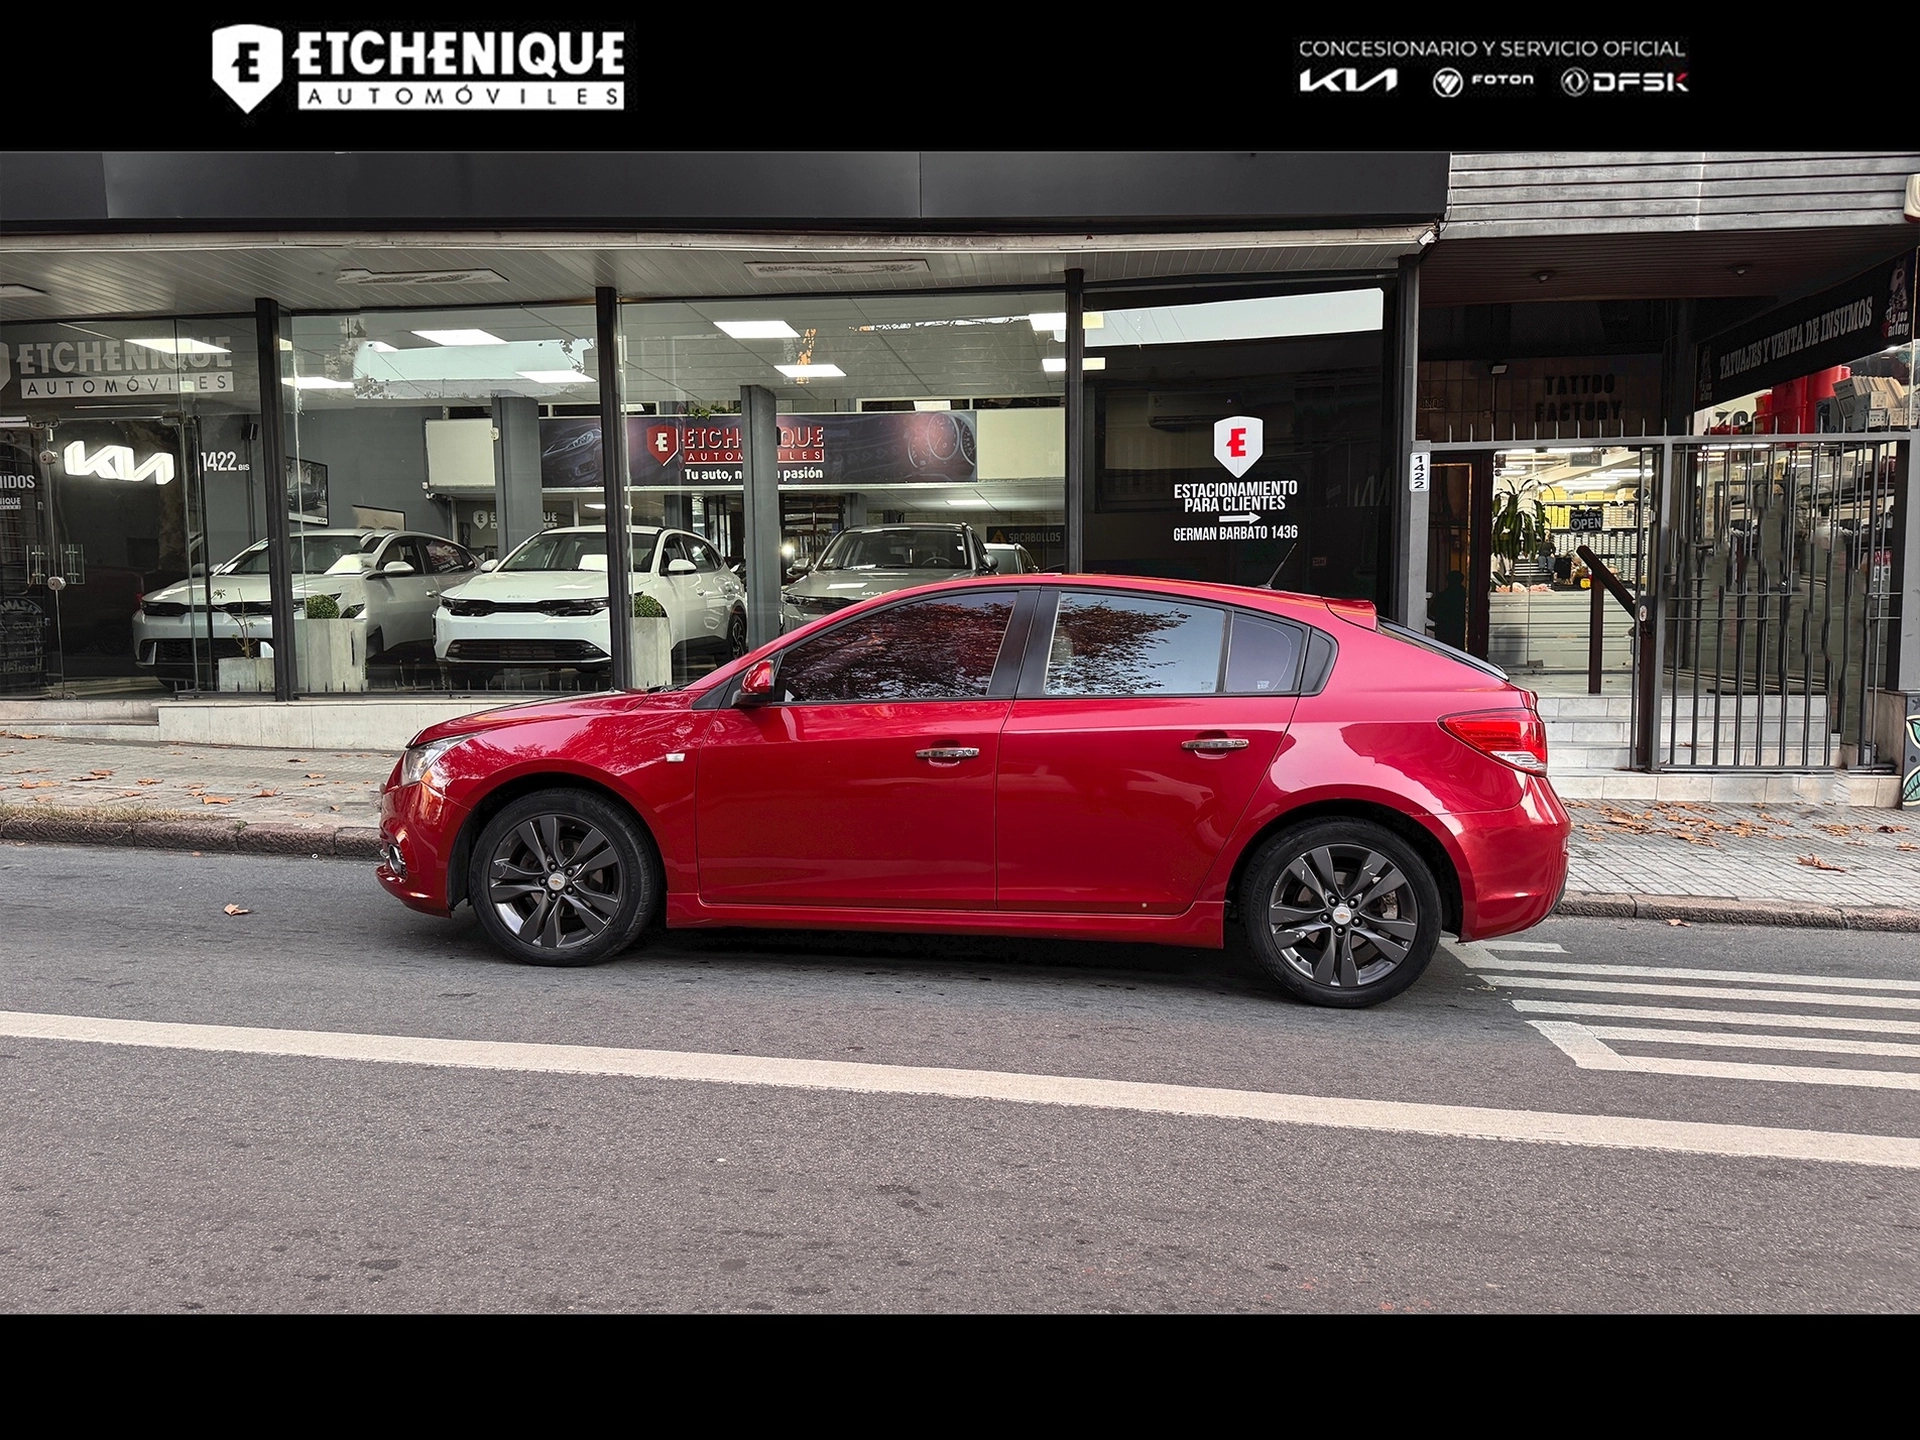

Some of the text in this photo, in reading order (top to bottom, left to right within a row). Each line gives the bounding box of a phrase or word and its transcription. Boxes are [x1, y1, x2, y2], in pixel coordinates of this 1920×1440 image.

[1719, 295, 1873, 380] TATUAJES Y VENTA DE INSUMOS
[27, 375, 226, 396] AUTOMÓVILES
[1544, 373, 1615, 395] TATTOO
[1534, 401, 1623, 422] FACTORY
[681, 426, 824, 450] ETCHQUE
[63, 439, 175, 486] KIA
[200, 451, 237, 471] 1422
[684, 468, 700, 480] Tu
[701, 469, 732, 482] auto,
[783, 468, 824, 481] pasión
[1414, 455, 1425, 489] 1422
[1174, 479, 1298, 499] ESTACIONAMIENTO
[1184, 495, 1286, 513] PARA CLIENTES
[1173, 524, 1298, 541] GERMAN BARBATO 1436
[1570, 518, 1602, 531] OPEN
[1008, 532, 1061, 543] SACABOLLOS
